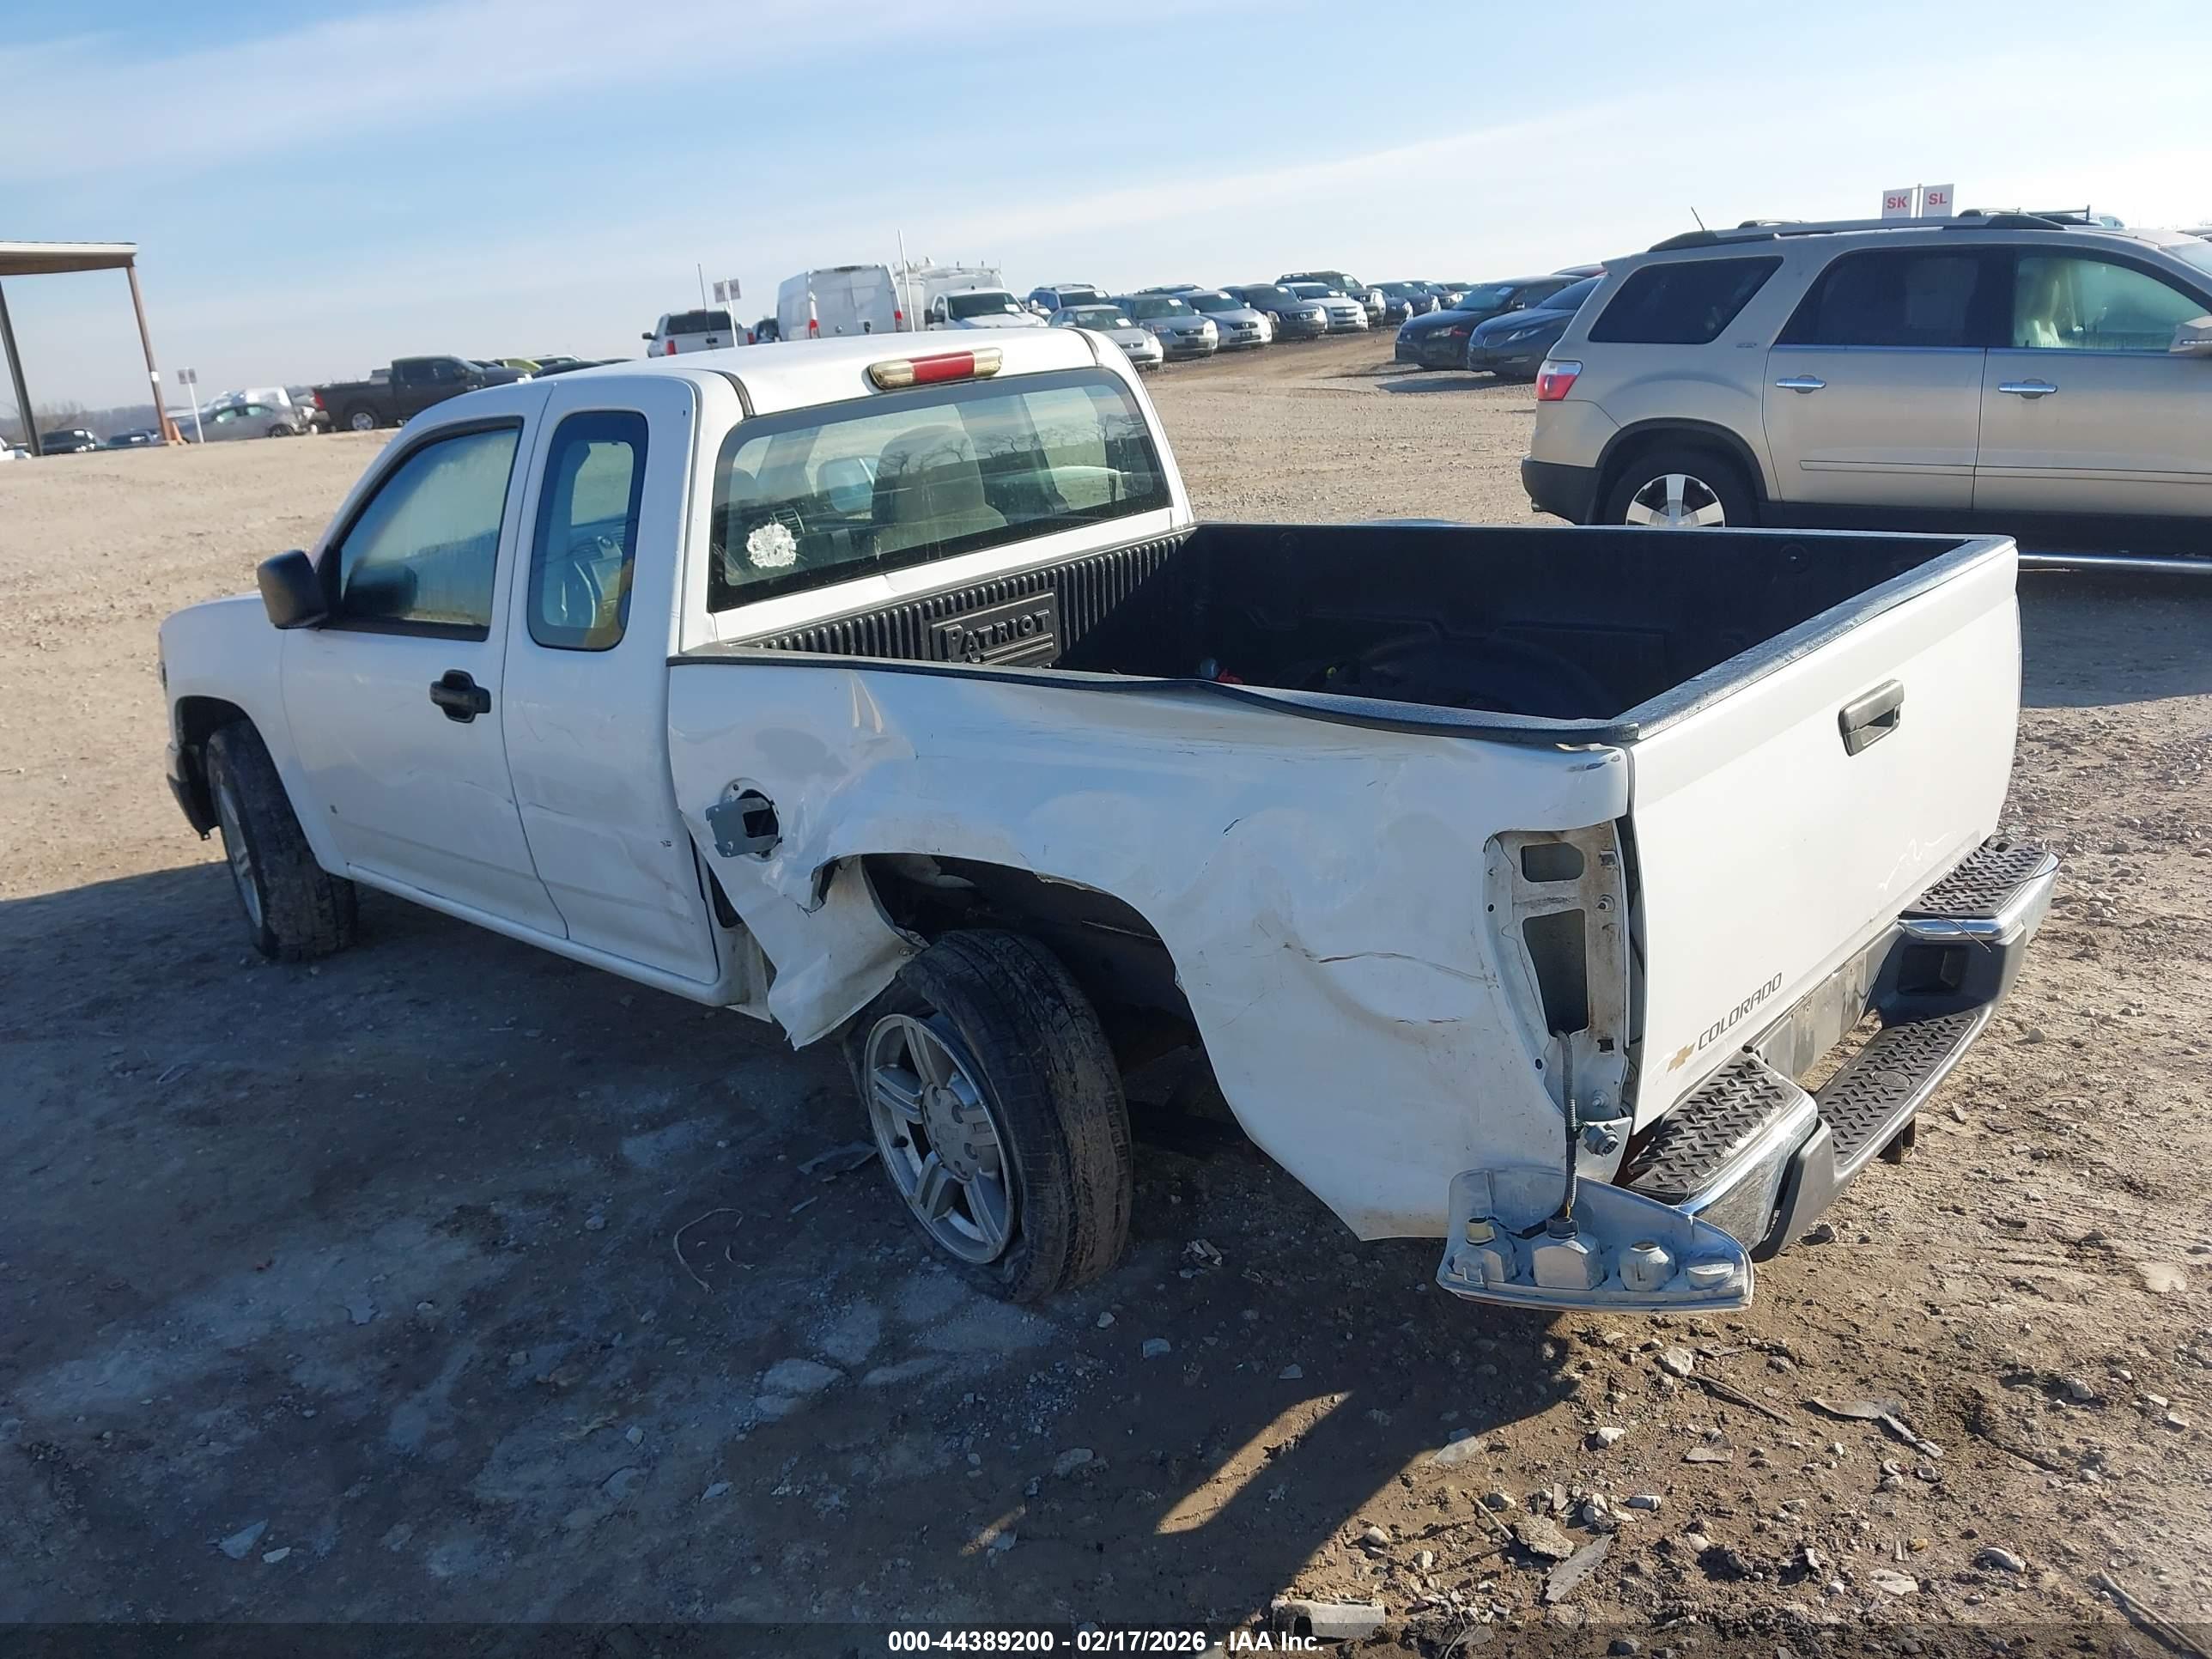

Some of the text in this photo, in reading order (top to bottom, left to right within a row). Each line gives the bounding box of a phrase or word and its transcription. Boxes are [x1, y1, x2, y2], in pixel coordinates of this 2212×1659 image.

[1887, 196, 1907, 210] SK
[1929, 192, 1948, 205] SL
[1698, 972, 1783, 1051] COLORADO
